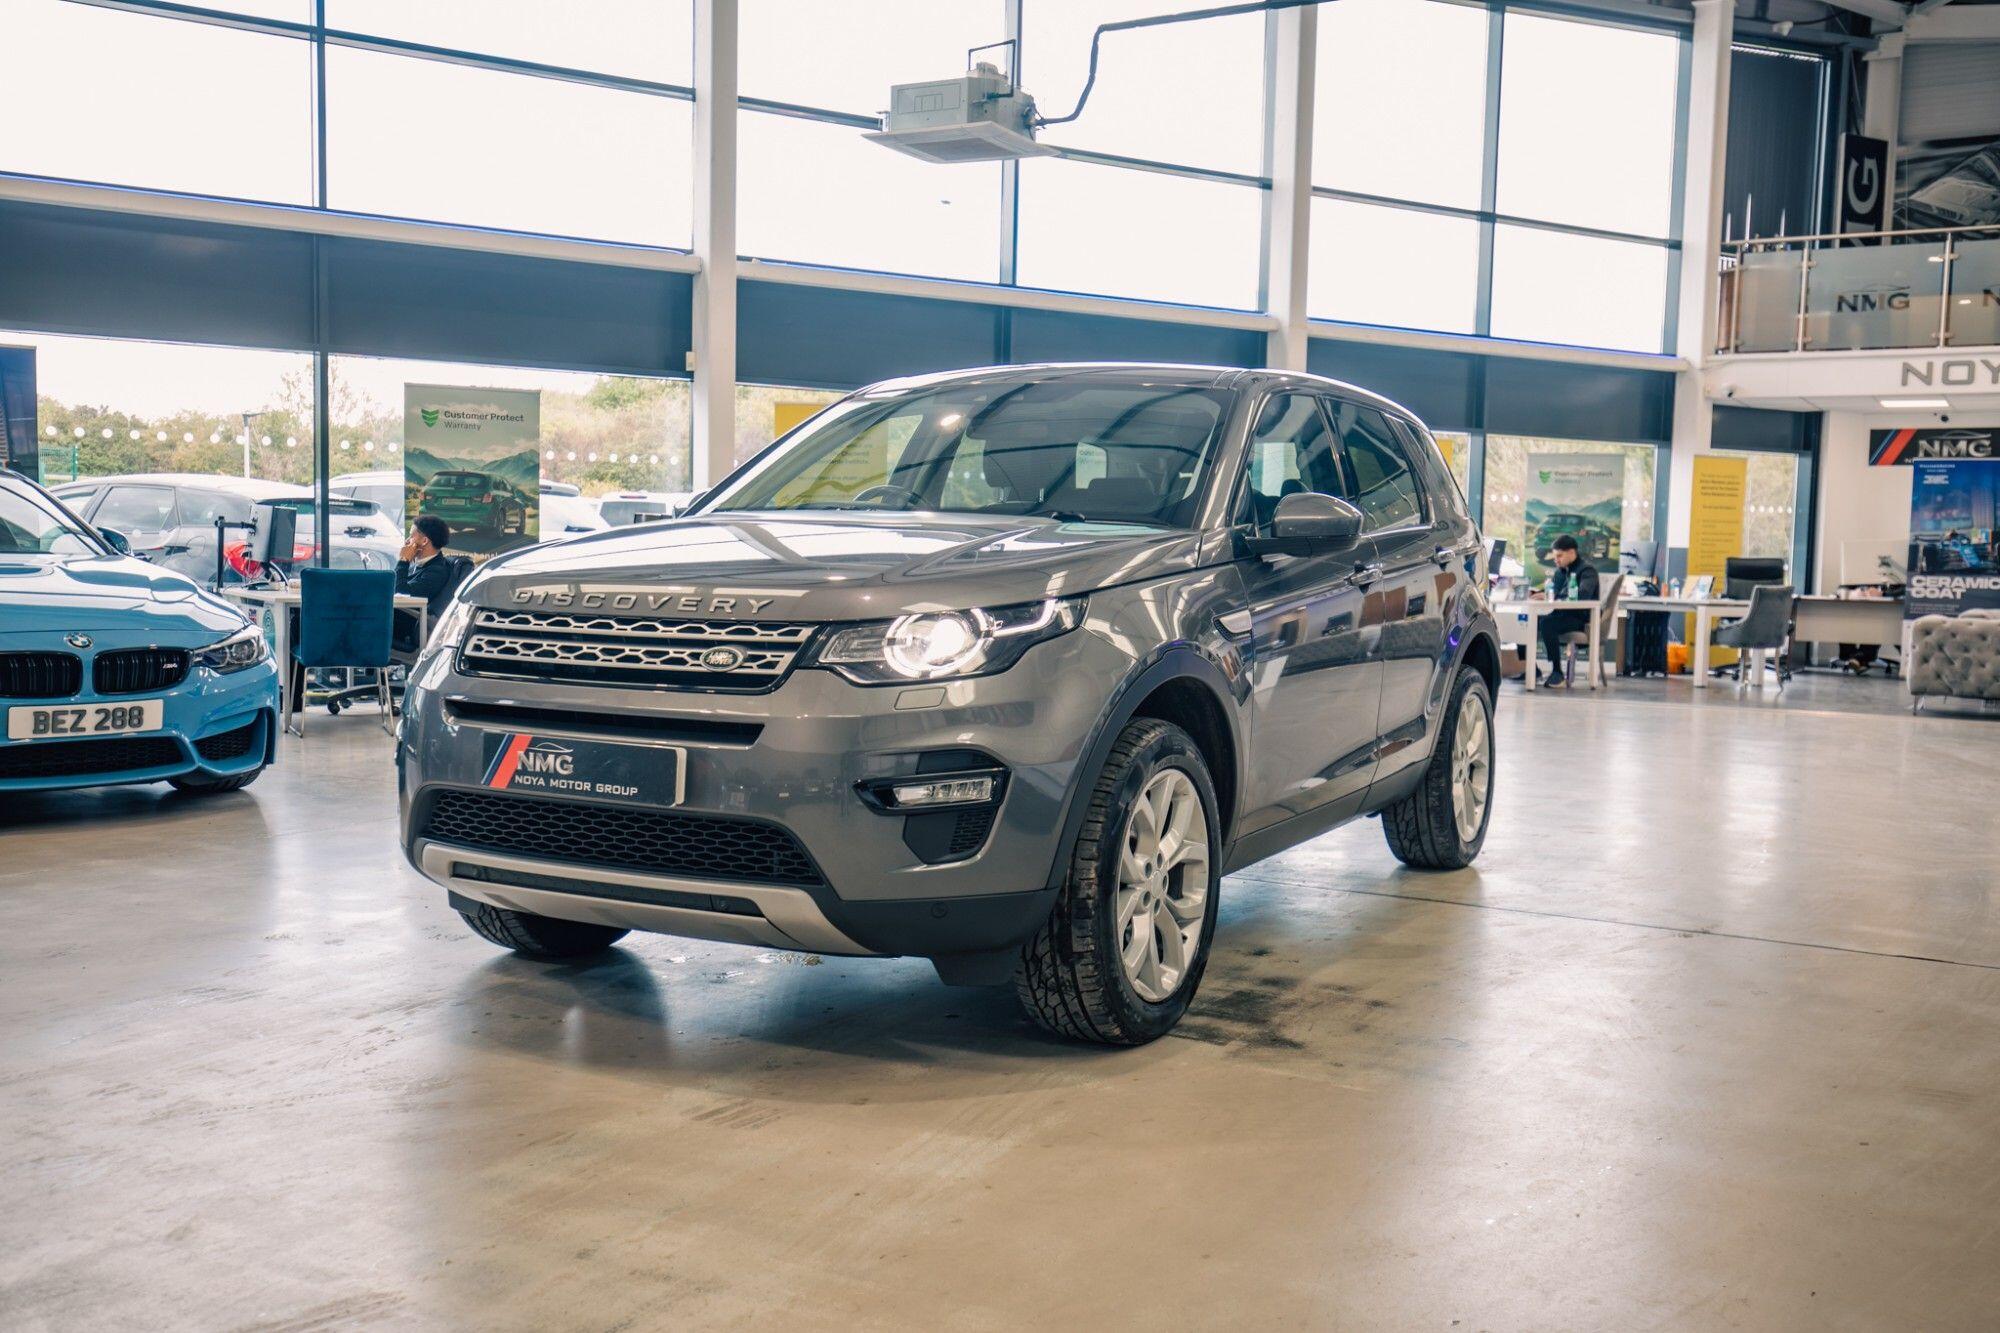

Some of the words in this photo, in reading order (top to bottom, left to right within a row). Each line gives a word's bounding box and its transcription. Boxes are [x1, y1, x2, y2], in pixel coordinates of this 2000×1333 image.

[1837, 292, 1910, 312] NMG
[444, 410, 489, 420] Customer
[490, 412, 525, 422] Protect
[444, 420, 482, 431] Warranty
[1918, 439, 1992, 458] NMG
[1911, 575, 2000, 590] CERAMIC
[511, 589, 774, 614] DISCOVERY
[1910, 587, 1967, 600] COAT
[32, 709, 87, 735] BEZ
[94, 705, 144, 731] 288
[516, 750, 574, 775] NMG
[514, 774, 546, 787] NOYA
[549, 778, 591, 792] MOTOR
[596, 783, 638, 797] GROUP
